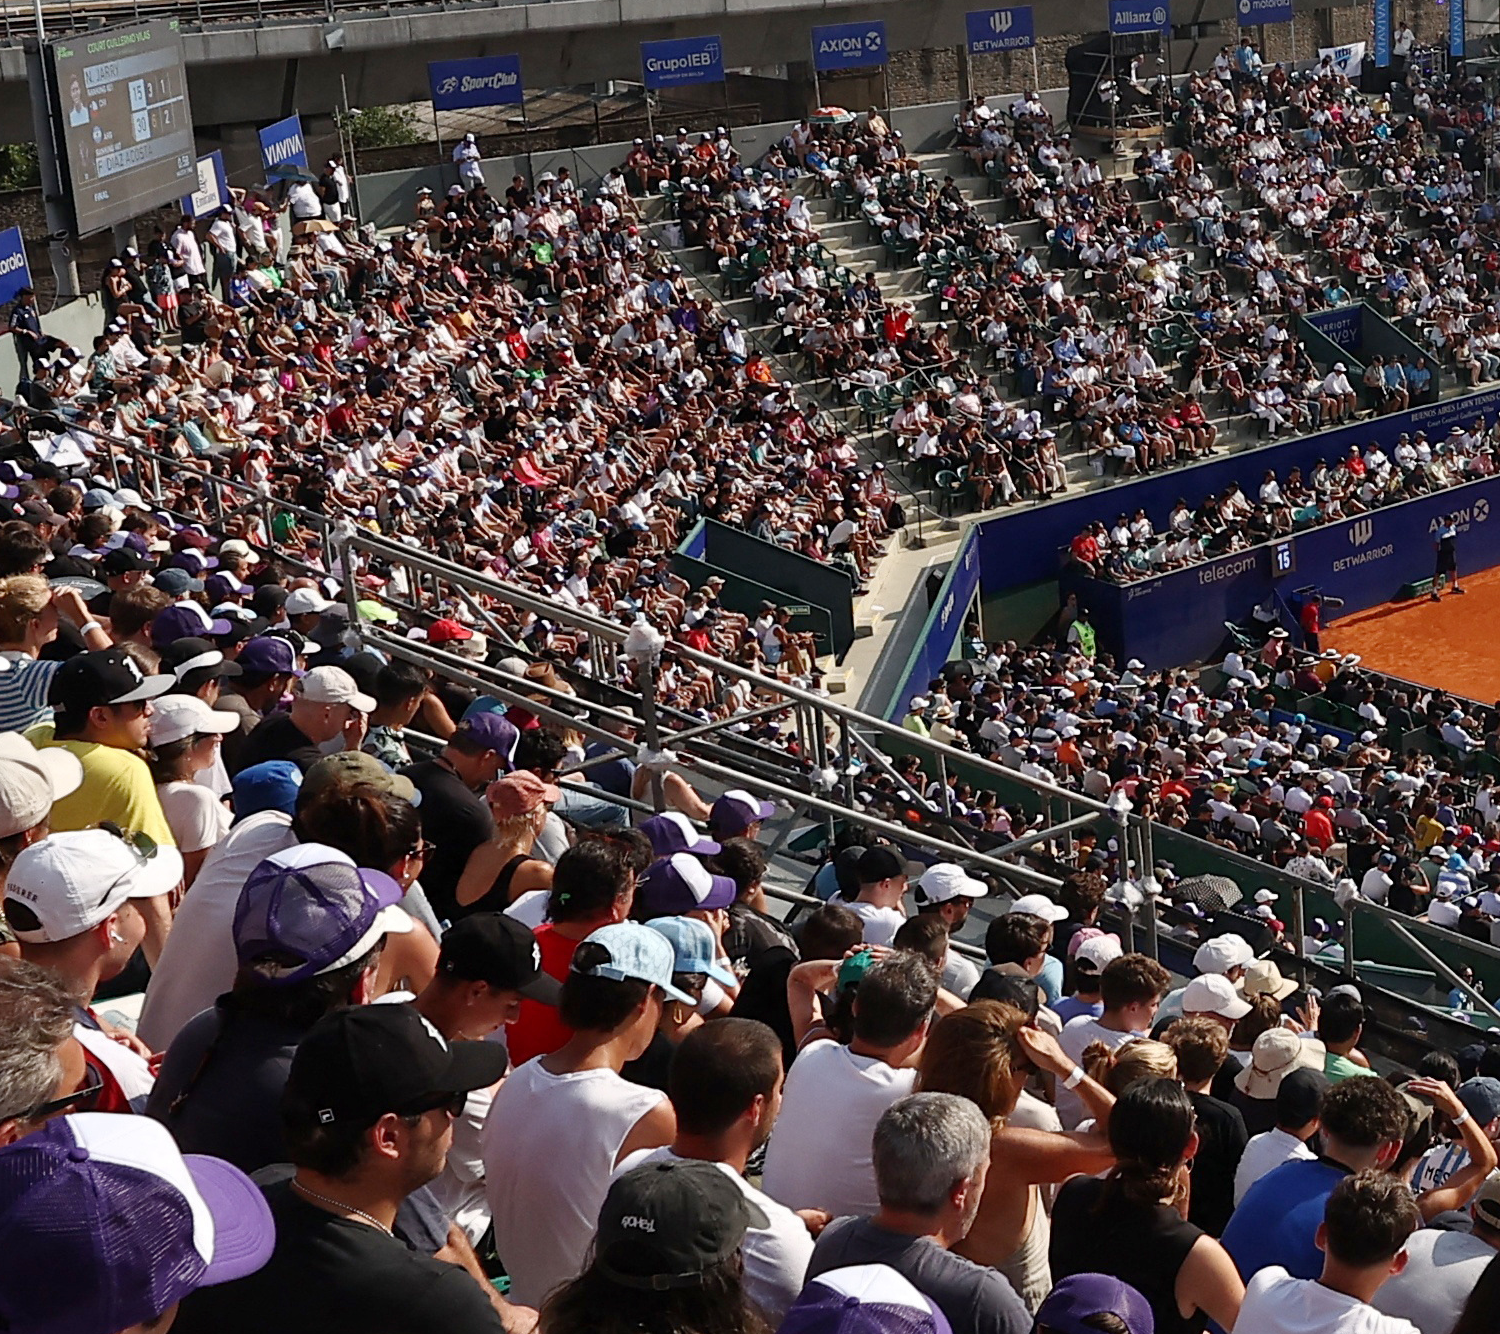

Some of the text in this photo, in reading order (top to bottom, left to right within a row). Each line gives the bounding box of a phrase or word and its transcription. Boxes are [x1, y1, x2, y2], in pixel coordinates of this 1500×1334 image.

[1114, 11, 1152, 25] Allianz
[1376, 1, 1387, 55] VIAVIVA
[87, 42, 106, 54] COURT
[819, 37, 862, 53] AXION
[972, 35, 1031, 52] BETWARRIOR
[97, 64, 120, 81] JARRY
[461, 72, 518, 93] SportClub
[133, 85, 144, 101] 15
[147, 82, 153, 98] 3
[160, 79, 166, 94] 1
[136, 116, 147, 133] 30
[164, 109, 171, 124] 2
[264, 133, 304, 168] VIAVIVA
[106, 154, 125, 171] DIAZ
[1319, 320, 1351, 333] ARRIOTT
[1411, 407, 1437, 422] BUENOS
[1438, 403, 1455, 416] AIRES
[1456, 399, 1474, 412] LAWN
[1474, 394, 1496, 408] TENNIS
[1429, 508, 1471, 534] AXON
[1277, 550, 1291, 571] 15
[1333, 543, 1394, 572] BETWARRIOR
[1198, 556, 1256, 585] telecom
[1424, 1165, 1452, 1186] MES
